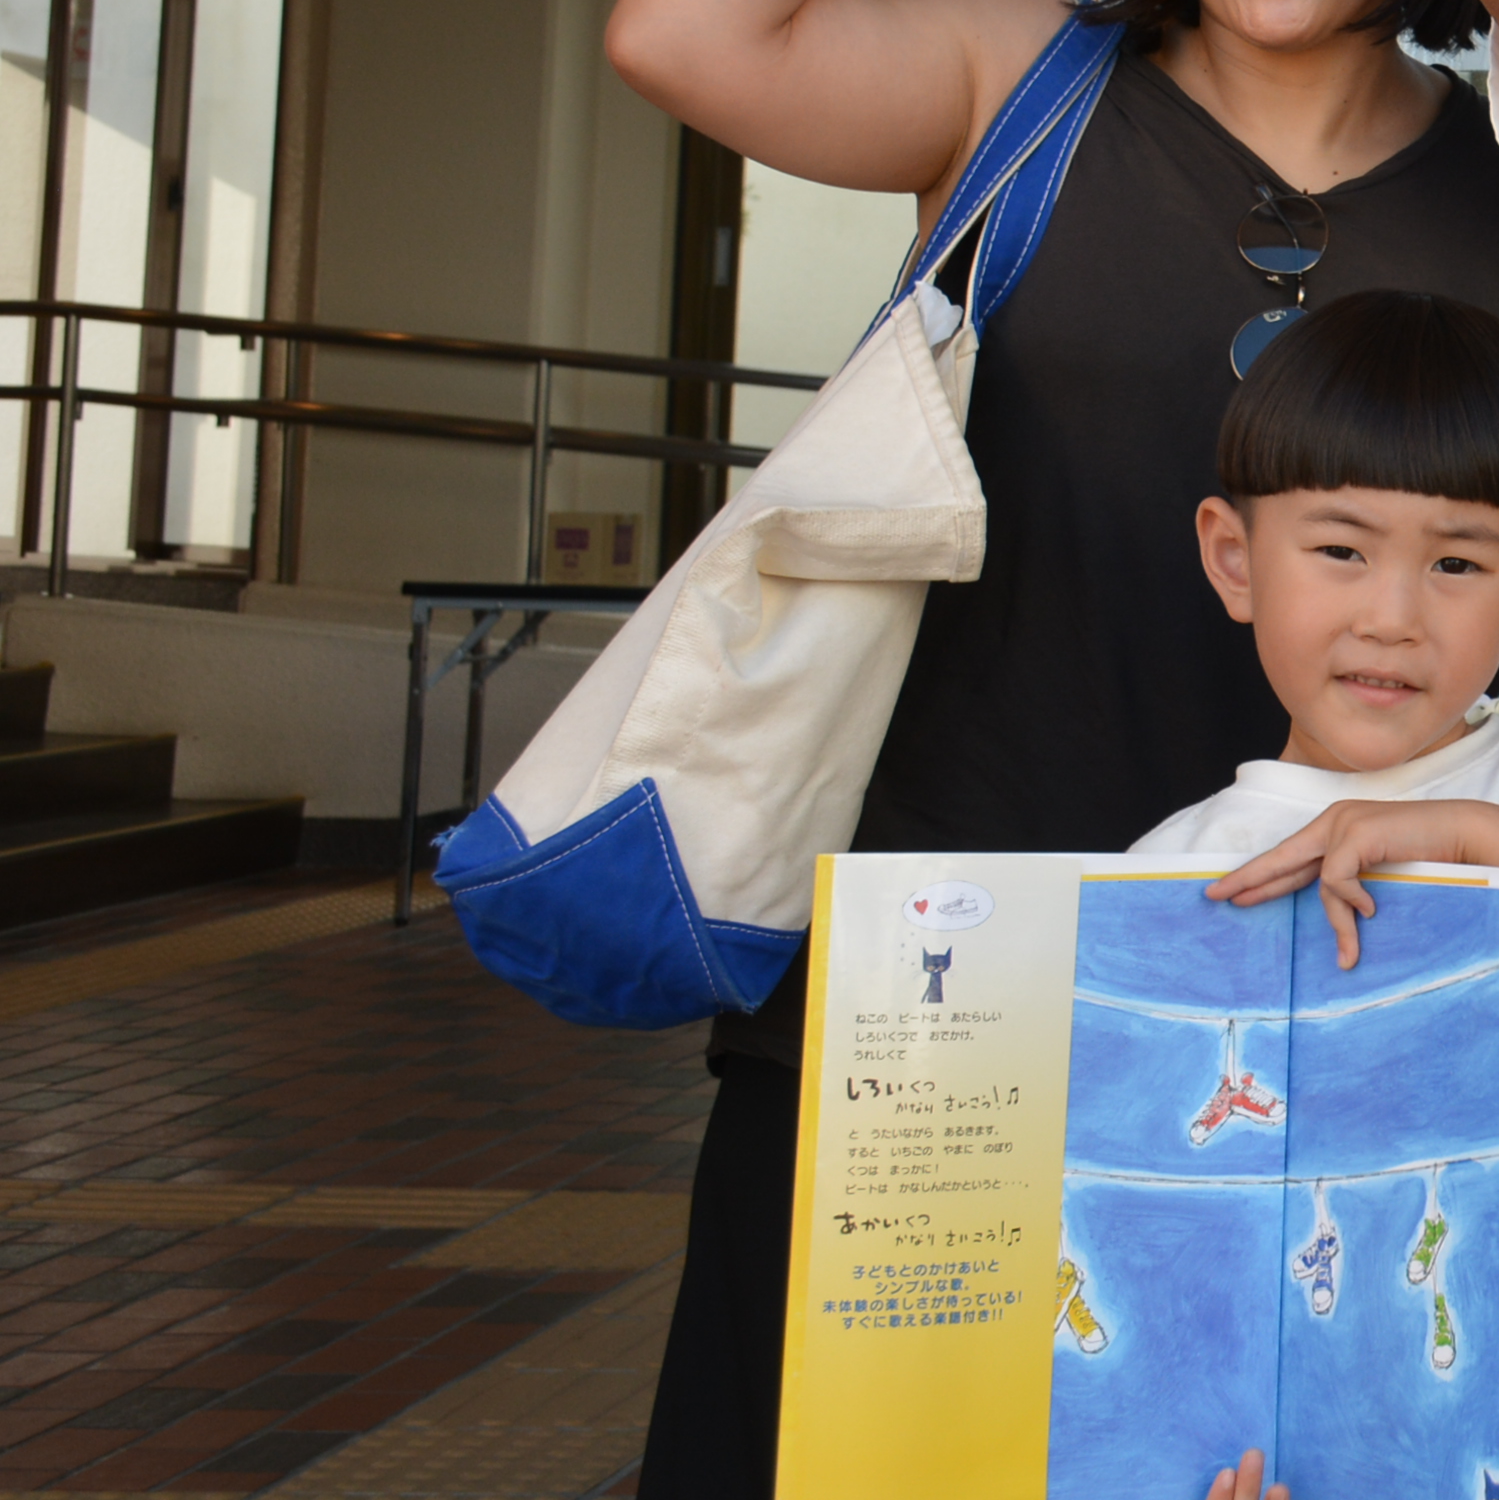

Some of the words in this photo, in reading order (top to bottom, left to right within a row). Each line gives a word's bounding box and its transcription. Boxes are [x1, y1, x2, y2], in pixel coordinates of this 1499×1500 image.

[855, 1013, 889, 1025] ねこの
[950, 1011, 1003, 1024] あたらしい
[855, 1031, 919, 1043] しろいくつで
[929, 1030, 976, 1042] おでかけ。
[853, 1049, 908, 1061] うれしくて
[894, 1102, 935, 1115] かなり
[848, 1129, 860, 1140] と
[870, 1128, 935, 1140] うたいながら
[943, 1125, 1000, 1137] あるきます。
[847, 1147, 881, 1159] すると
[890, 1146, 934, 1158] いちごの
[943, 1144, 975, 1156] やまに
[983, 1142, 1014, 1154] のぼり
[846, 1165, 879, 1177] くつは
[895, 1233, 935, 1247] かなり
[852, 1259, 1001, 1280] 子どもとのかけあいと
[874, 1277, 971, 1296] シンプルな歌。
[822, 1290, 1023, 1314] 未体験の楽しさが待っている!
